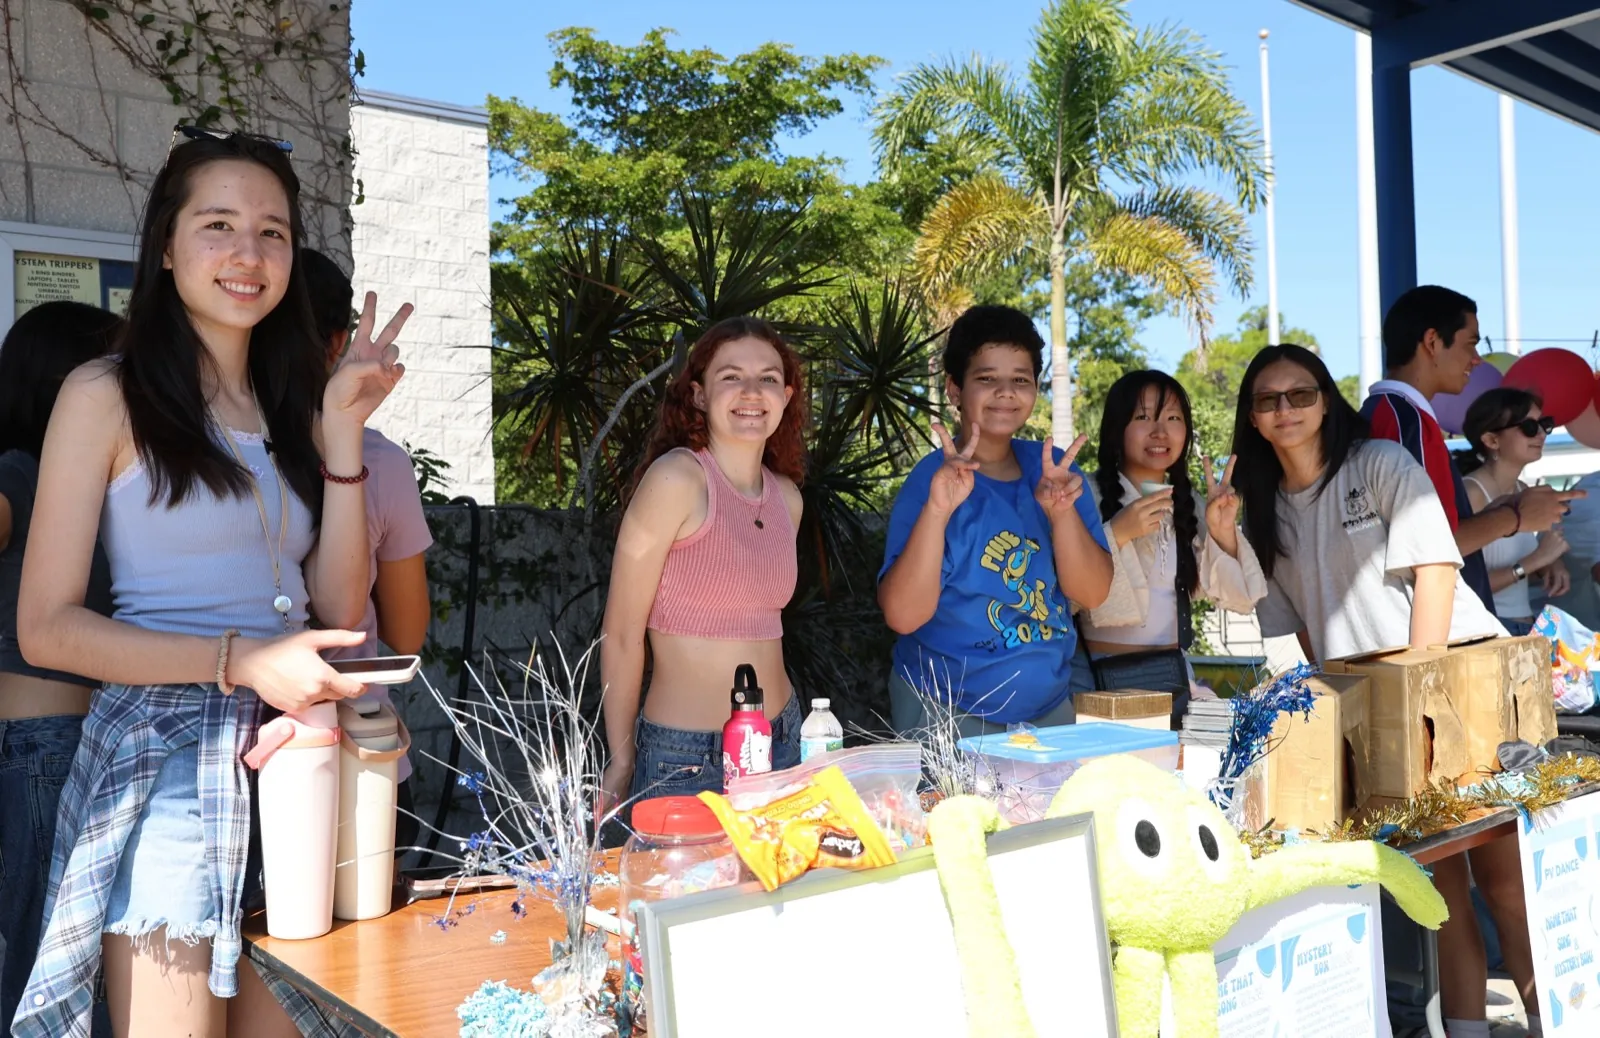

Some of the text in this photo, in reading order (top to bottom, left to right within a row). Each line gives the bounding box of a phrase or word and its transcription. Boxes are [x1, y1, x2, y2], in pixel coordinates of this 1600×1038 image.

[49, 260, 94, 270] TRIPPERS
[980, 530, 1022, 573] PINE
[1002, 623, 1053, 650] 2029
[1544, 858, 1580, 881] PV DANCE
[1296, 941, 1333, 967] MYSTERY
[1313, 959, 1330, 977] BOX
[1230, 971, 1255, 993] THAT
